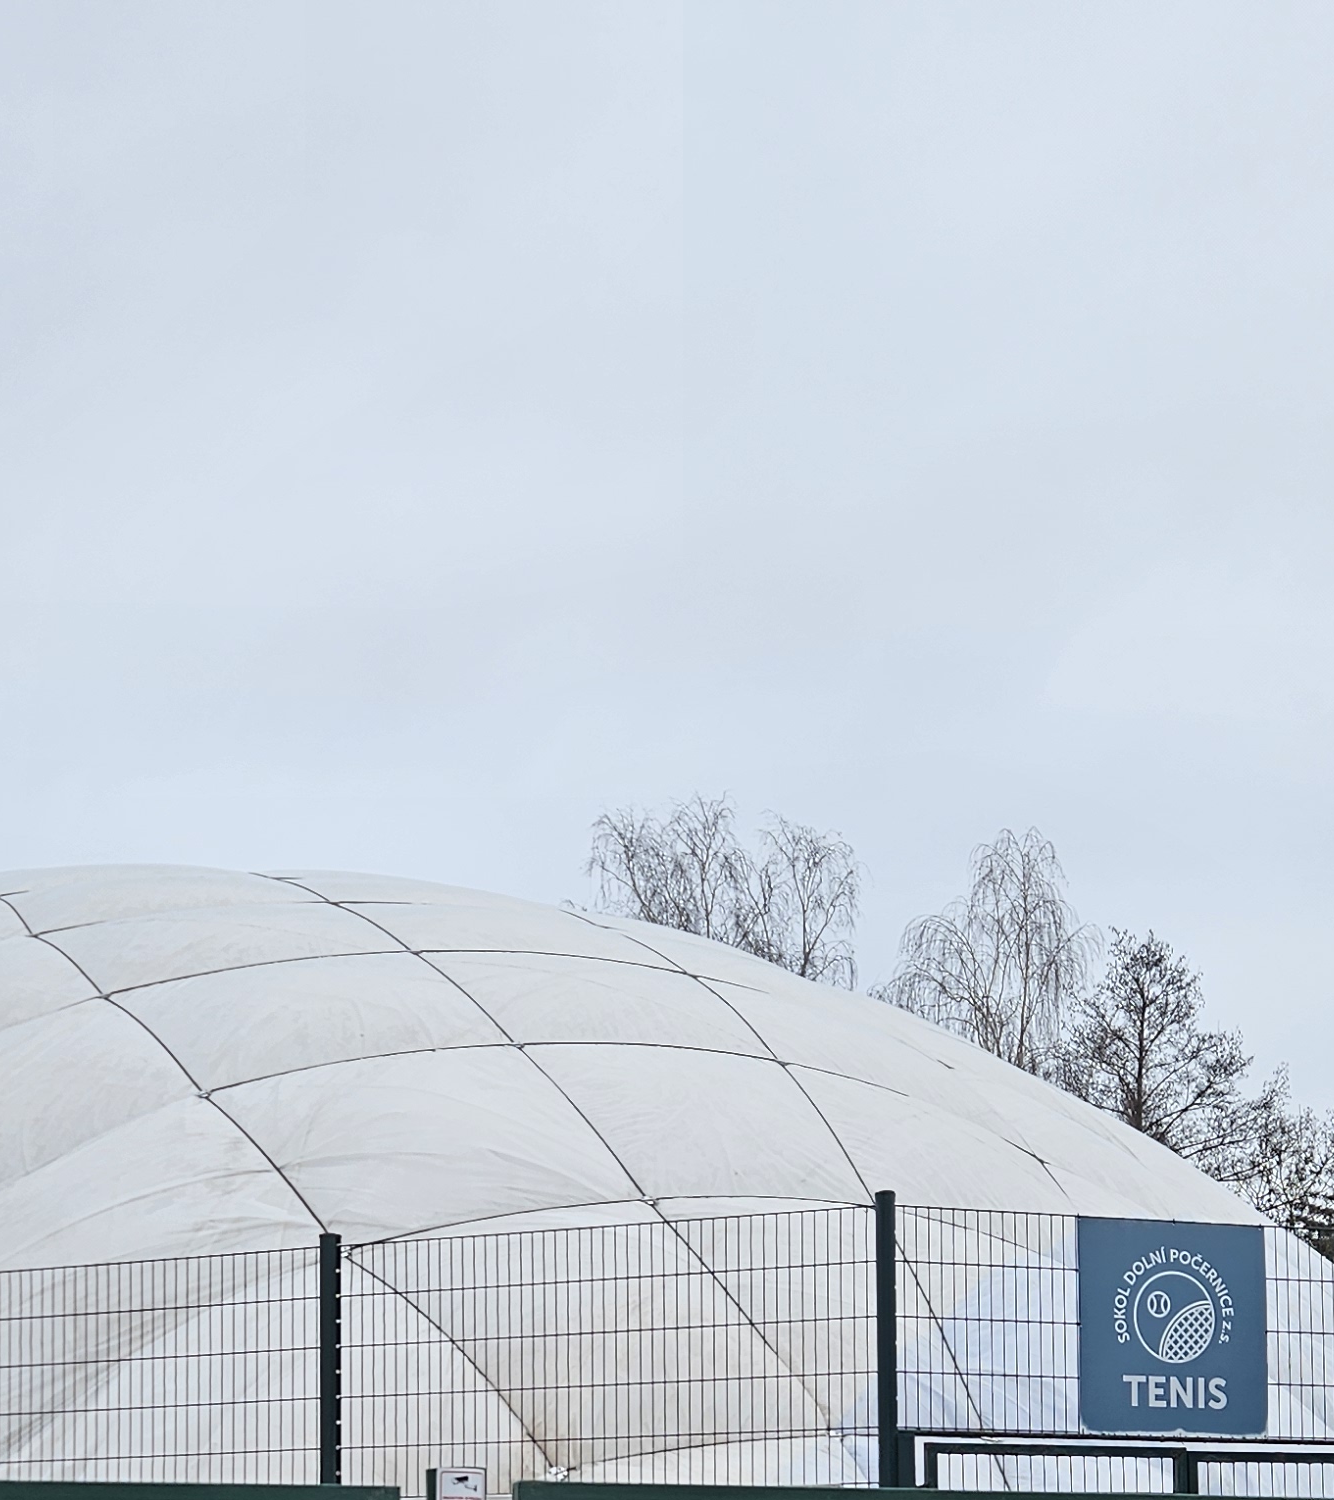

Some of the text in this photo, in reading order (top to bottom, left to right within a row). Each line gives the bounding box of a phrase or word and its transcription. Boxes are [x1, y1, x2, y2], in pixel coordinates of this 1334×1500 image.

[1113, 1287, 1131, 1344] SOKOL
[1123, 1246, 1167, 1286] DOLNÍ
[1169, 1248, 1235, 1317] POČERNICE
[1122, 1374, 1228, 1410] TENIS
